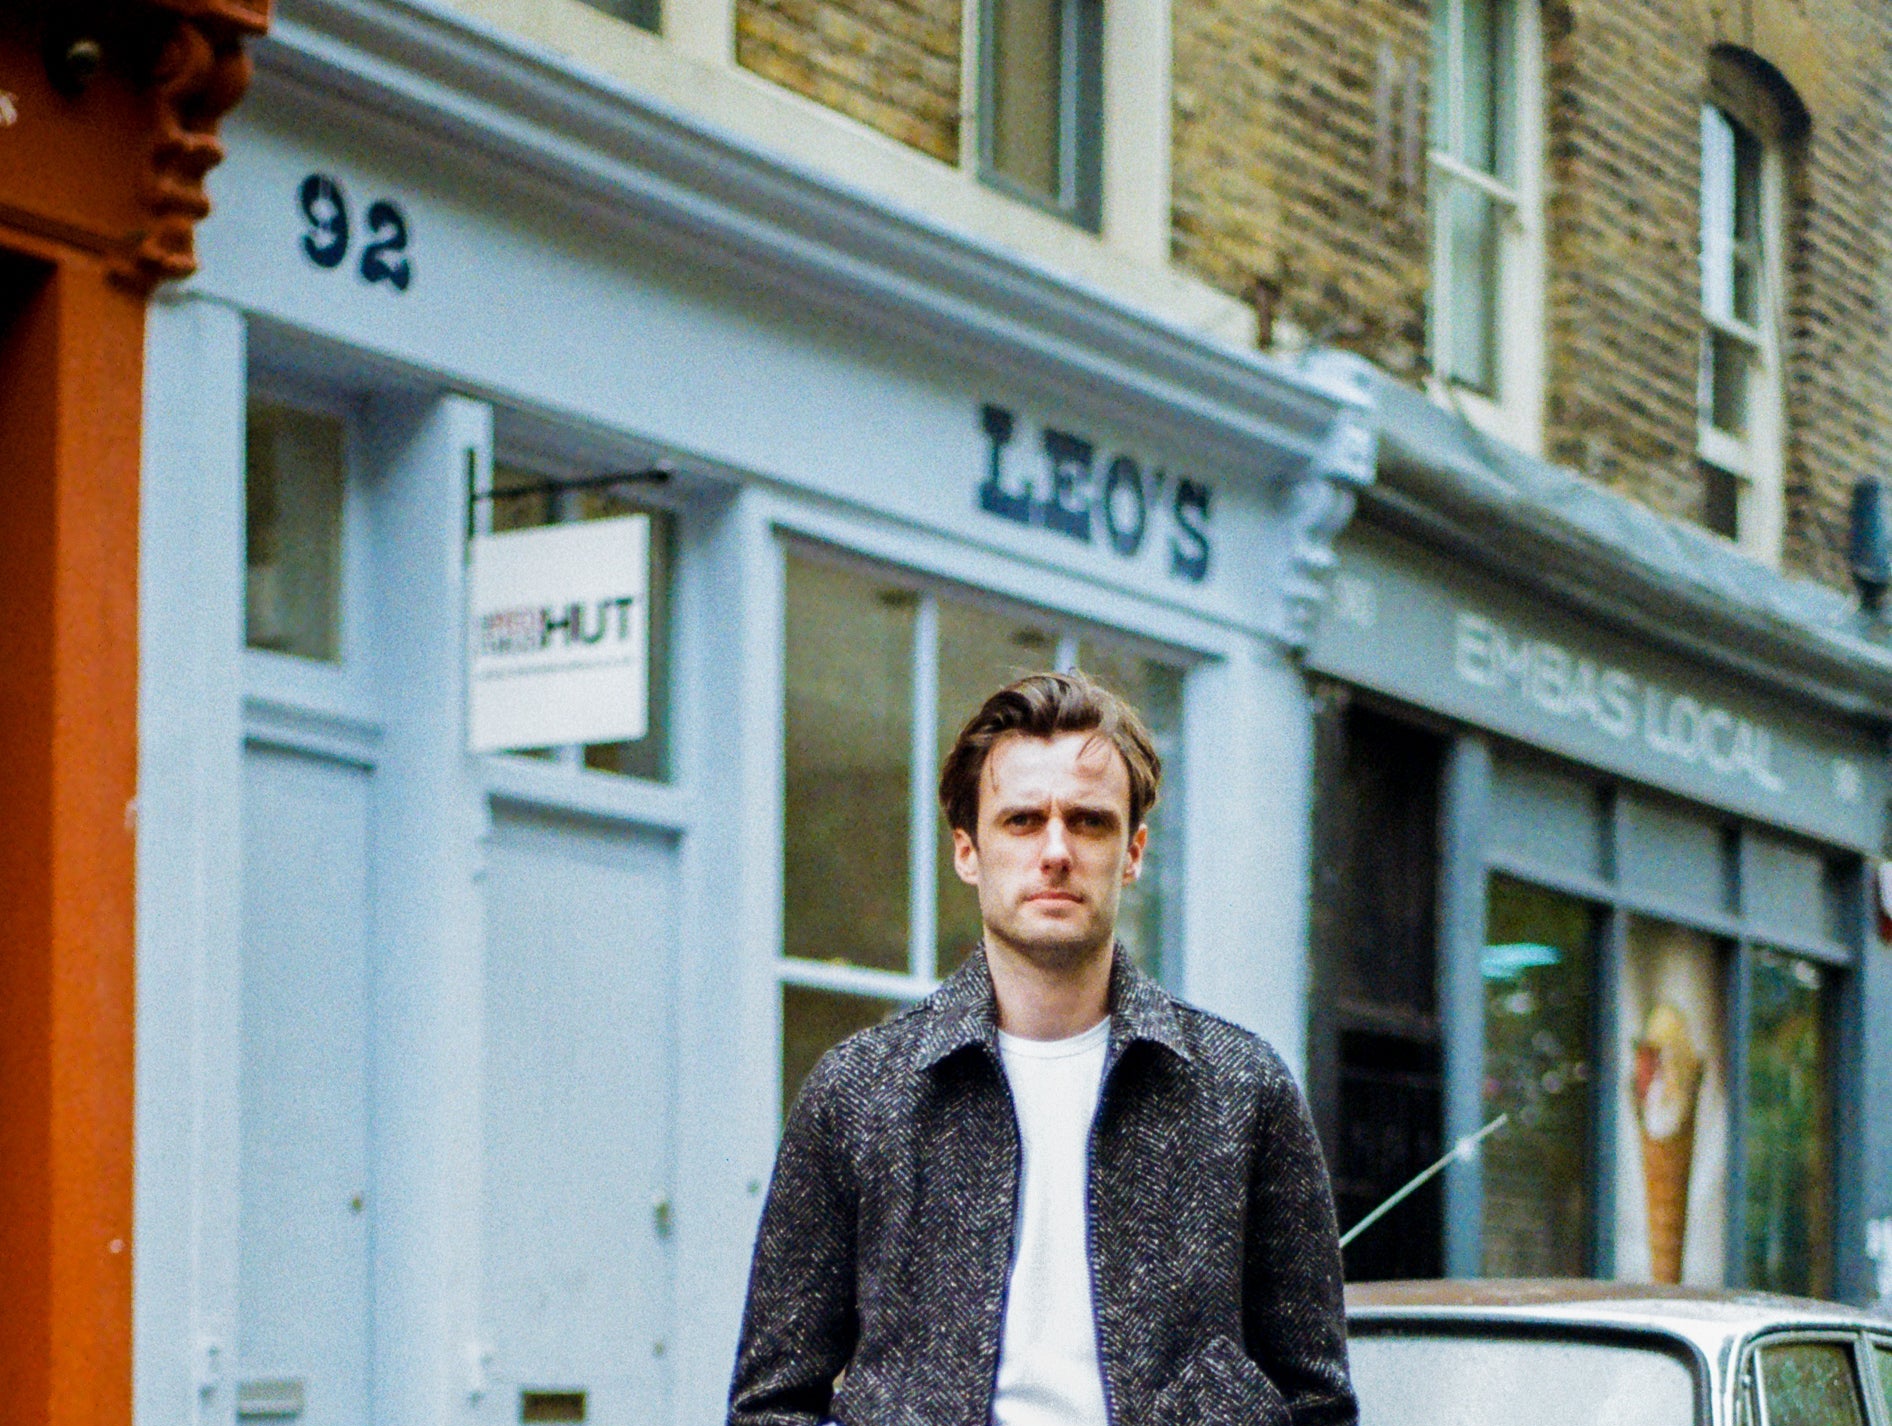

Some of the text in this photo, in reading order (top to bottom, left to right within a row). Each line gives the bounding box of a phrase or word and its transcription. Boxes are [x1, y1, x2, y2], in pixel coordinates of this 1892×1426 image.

[299, 174, 410, 291] 92
[979, 402, 1212, 582] LEO'S
[540, 597, 633, 647] HUT
[1645, 685, 1784, 793] LOCAL
